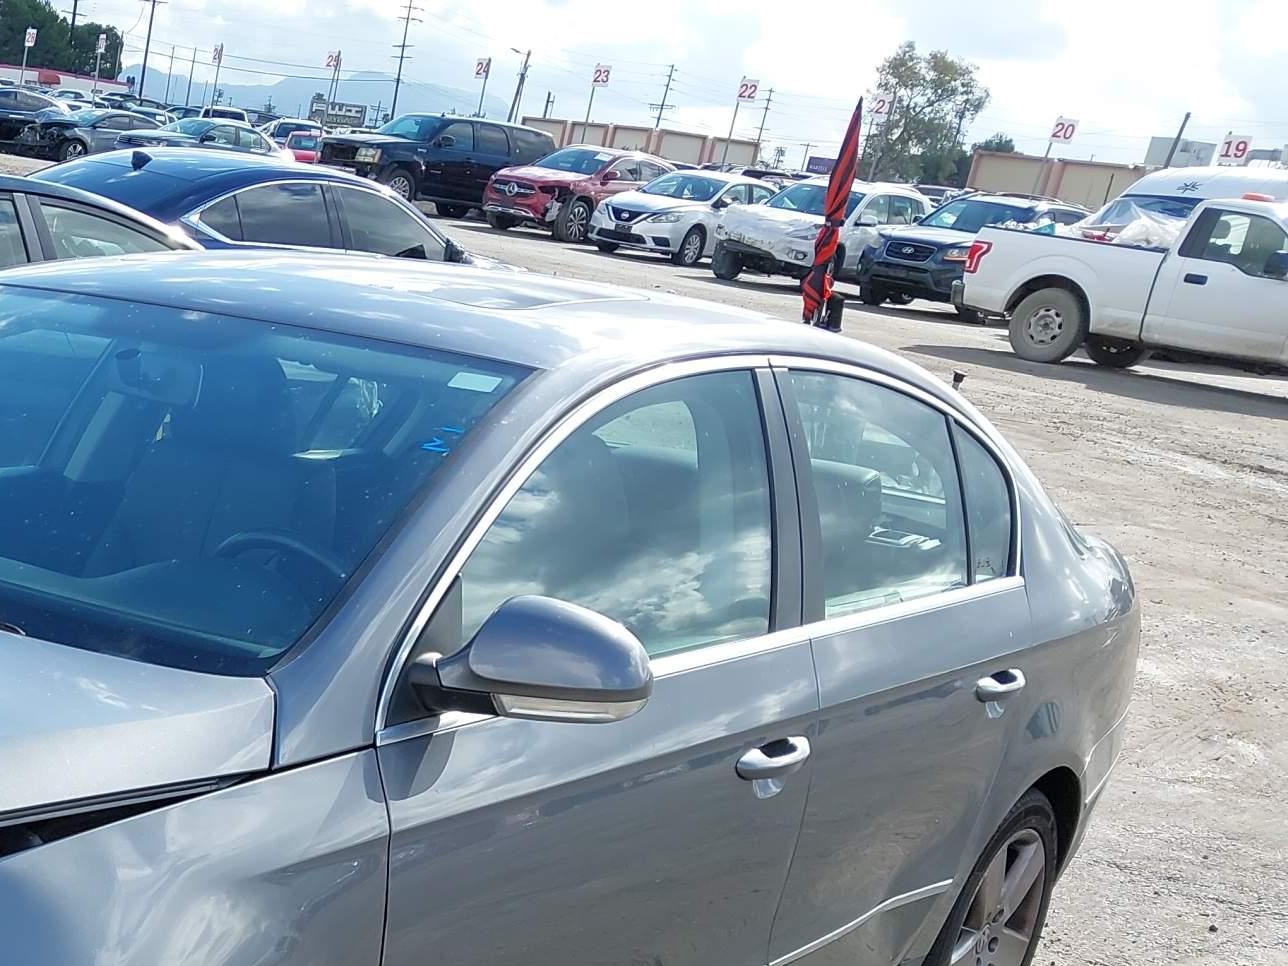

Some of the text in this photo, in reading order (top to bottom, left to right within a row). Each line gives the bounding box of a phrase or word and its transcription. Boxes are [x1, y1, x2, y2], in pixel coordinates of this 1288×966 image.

[475, 62, 490, 77] 24
[593, 69, 611, 83] 23
[738, 83, 758, 99] 22
[1051, 122, 1075, 140] 20
[1219, 140, 1248, 158] 19
